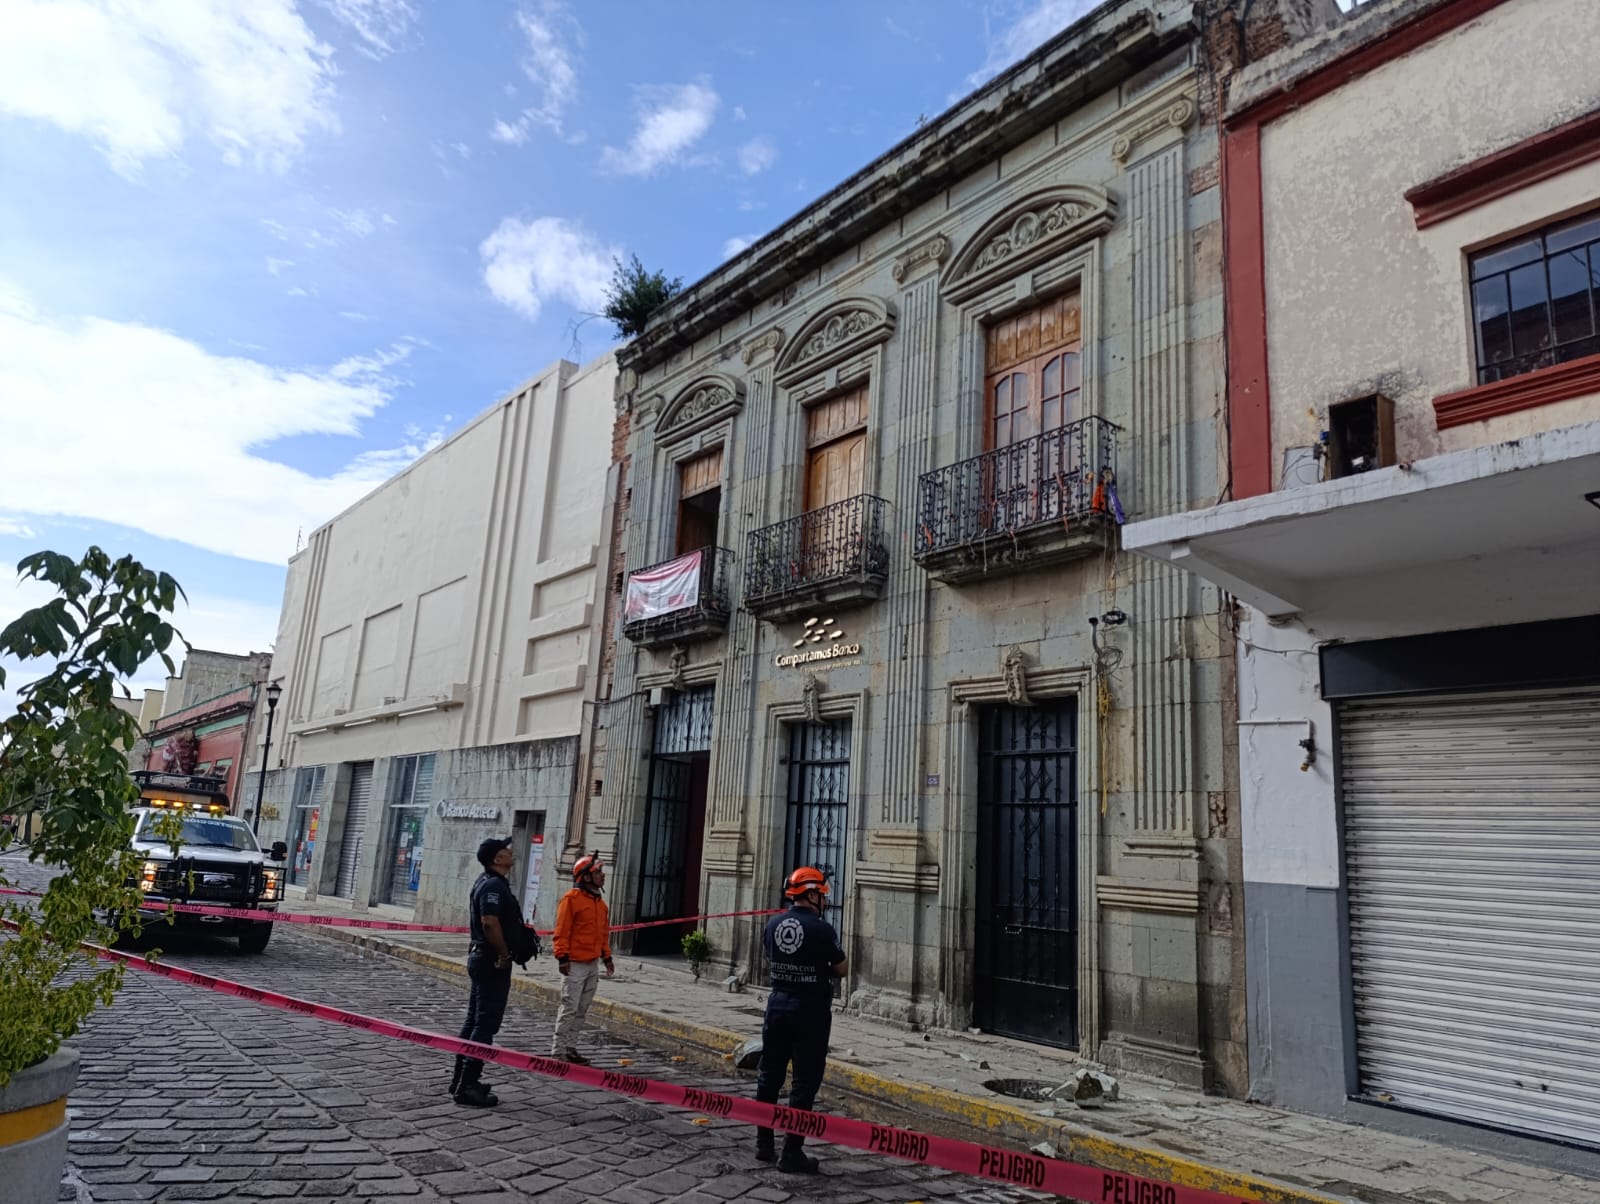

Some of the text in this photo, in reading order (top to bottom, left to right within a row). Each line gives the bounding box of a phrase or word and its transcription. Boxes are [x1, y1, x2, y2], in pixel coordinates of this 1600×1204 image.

[775, 648, 832, 668] Compartamos
[832, 643, 859, 657] Banco
[527, 1057, 570, 1077] PELIGRO
[601, 1071, 648, 1095] PELIGRO
[681, 1088, 733, 1115] PELIGRO
[771, 1106, 827, 1137] PELIGRO
[869, 1126, 929, 1161] PELIGRO
[978, 1148, 1045, 1187] PELIGRO
[1102, 1173, 1176, 1204] PELIGRO
